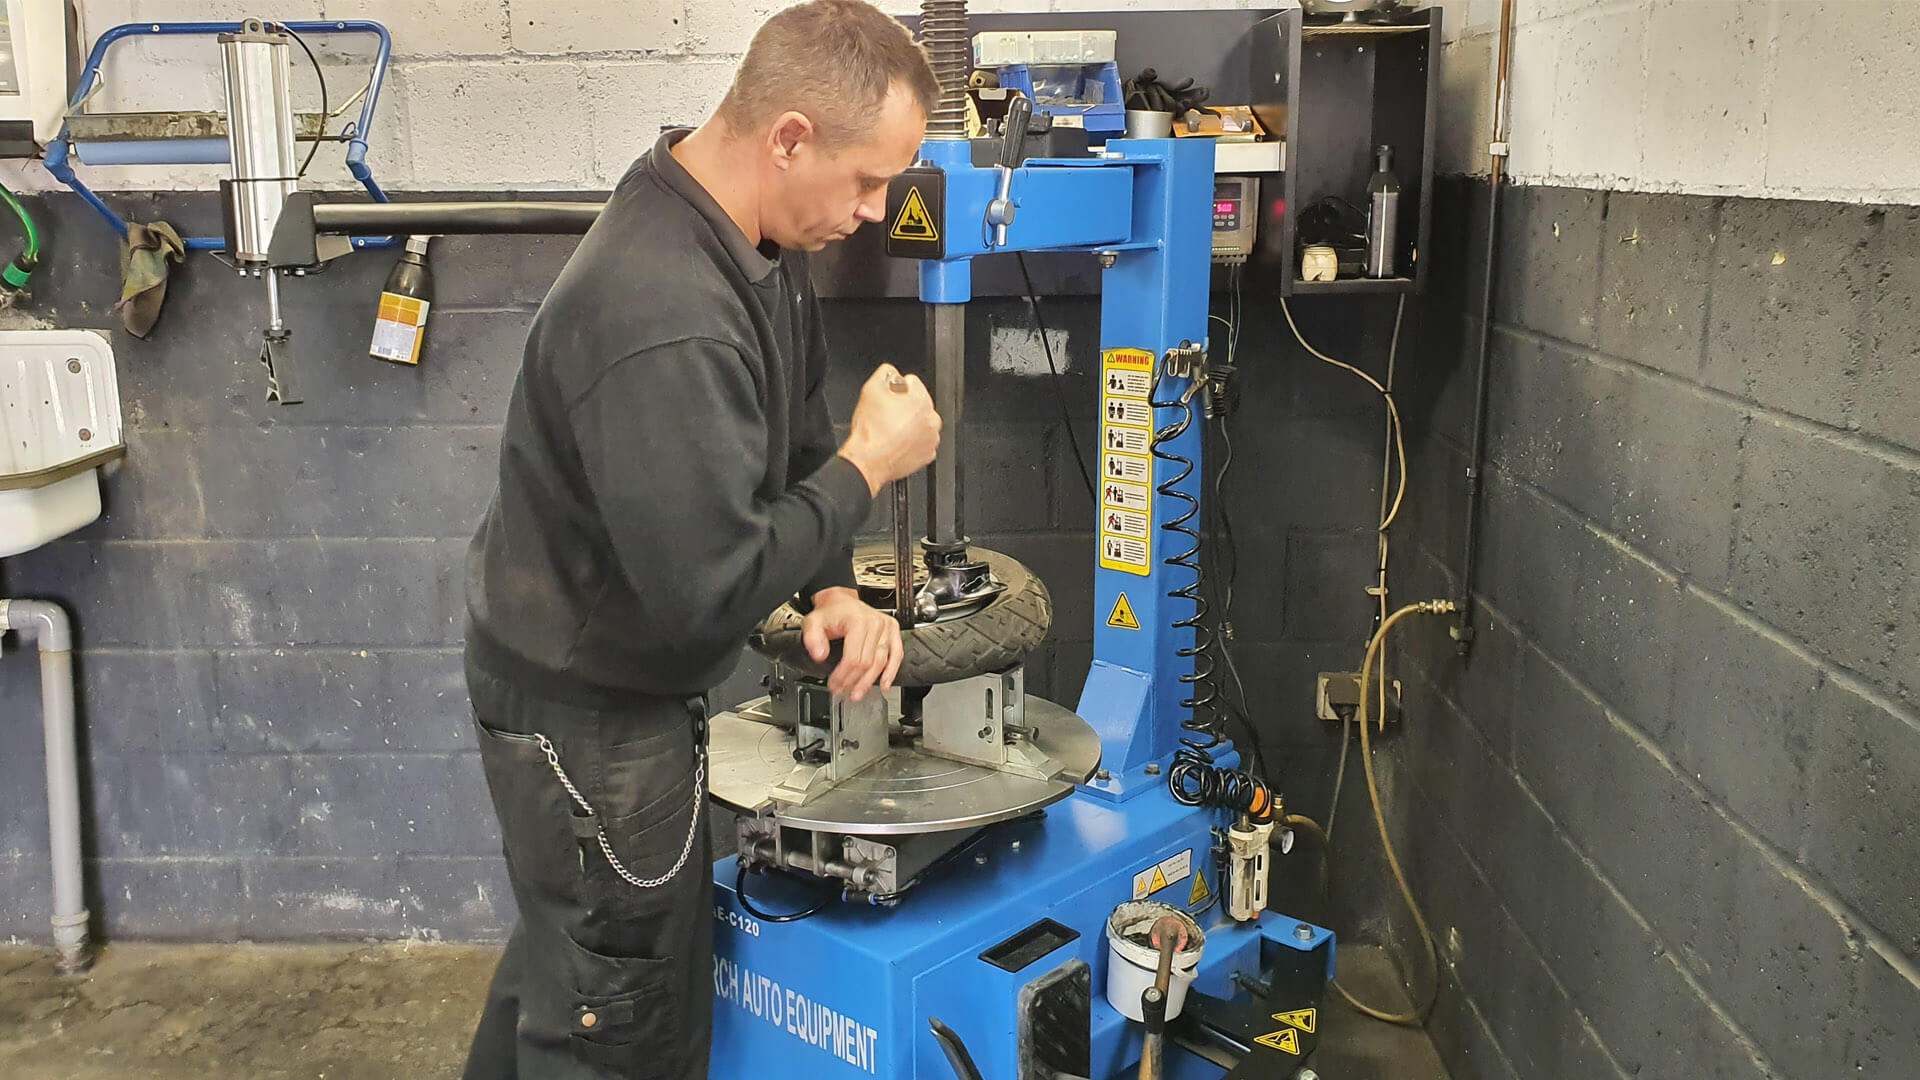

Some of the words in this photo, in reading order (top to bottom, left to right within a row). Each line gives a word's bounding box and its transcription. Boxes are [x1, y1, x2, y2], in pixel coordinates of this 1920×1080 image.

[1115, 354, 1149, 366] WARNING
[712, 905, 760, 937] E-C120
[743, 968, 783, 1027] AUTO
[786, 988, 878, 1075] EQUIPMENT
